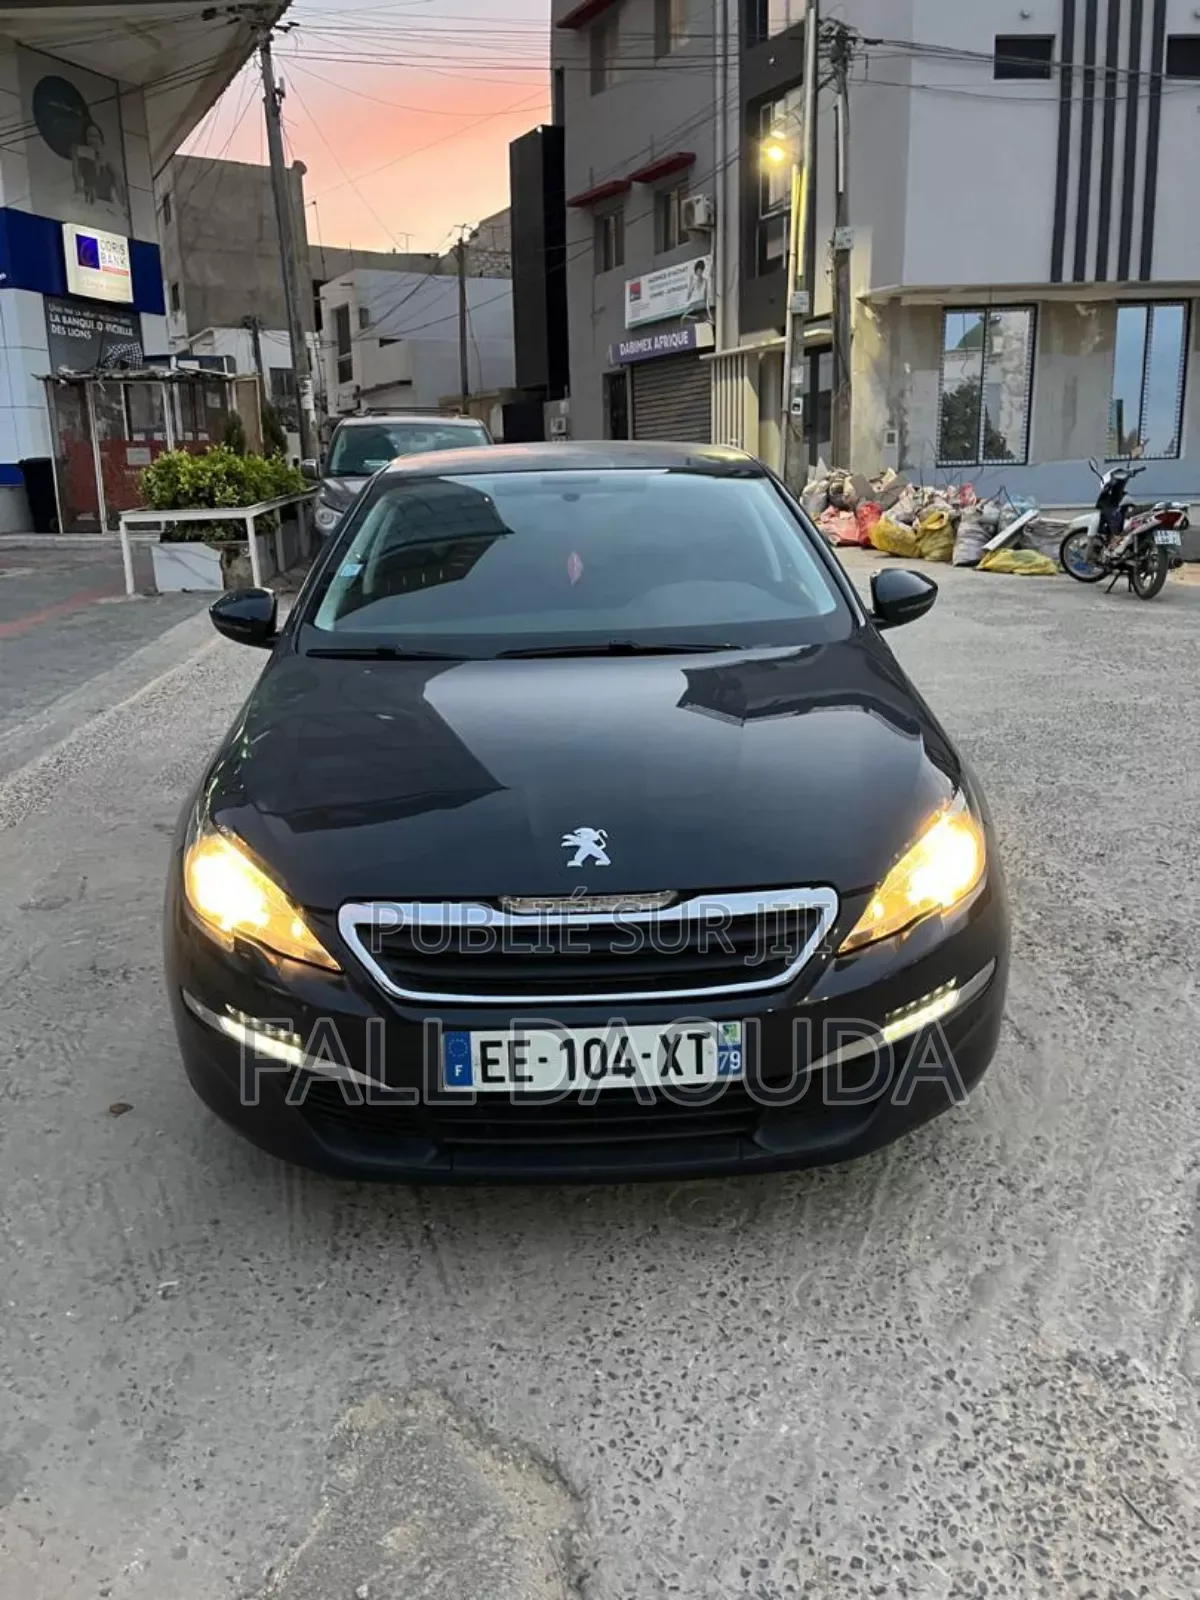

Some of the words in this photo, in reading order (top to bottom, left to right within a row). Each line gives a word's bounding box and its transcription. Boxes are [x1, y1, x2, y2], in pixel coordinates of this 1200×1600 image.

[49, 313, 60, 323] LA
[51, 323, 66, 336] DES
[67, 327, 92, 340] LIONS
[619, 337, 653, 356] DABIMEX
[654, 331, 689, 350] AFRIQUE
[479, 1032, 711, 1084] EE-104-XT
[718, 1050, 741, 1071] 79
[454, 1065, 463, 1077] F
